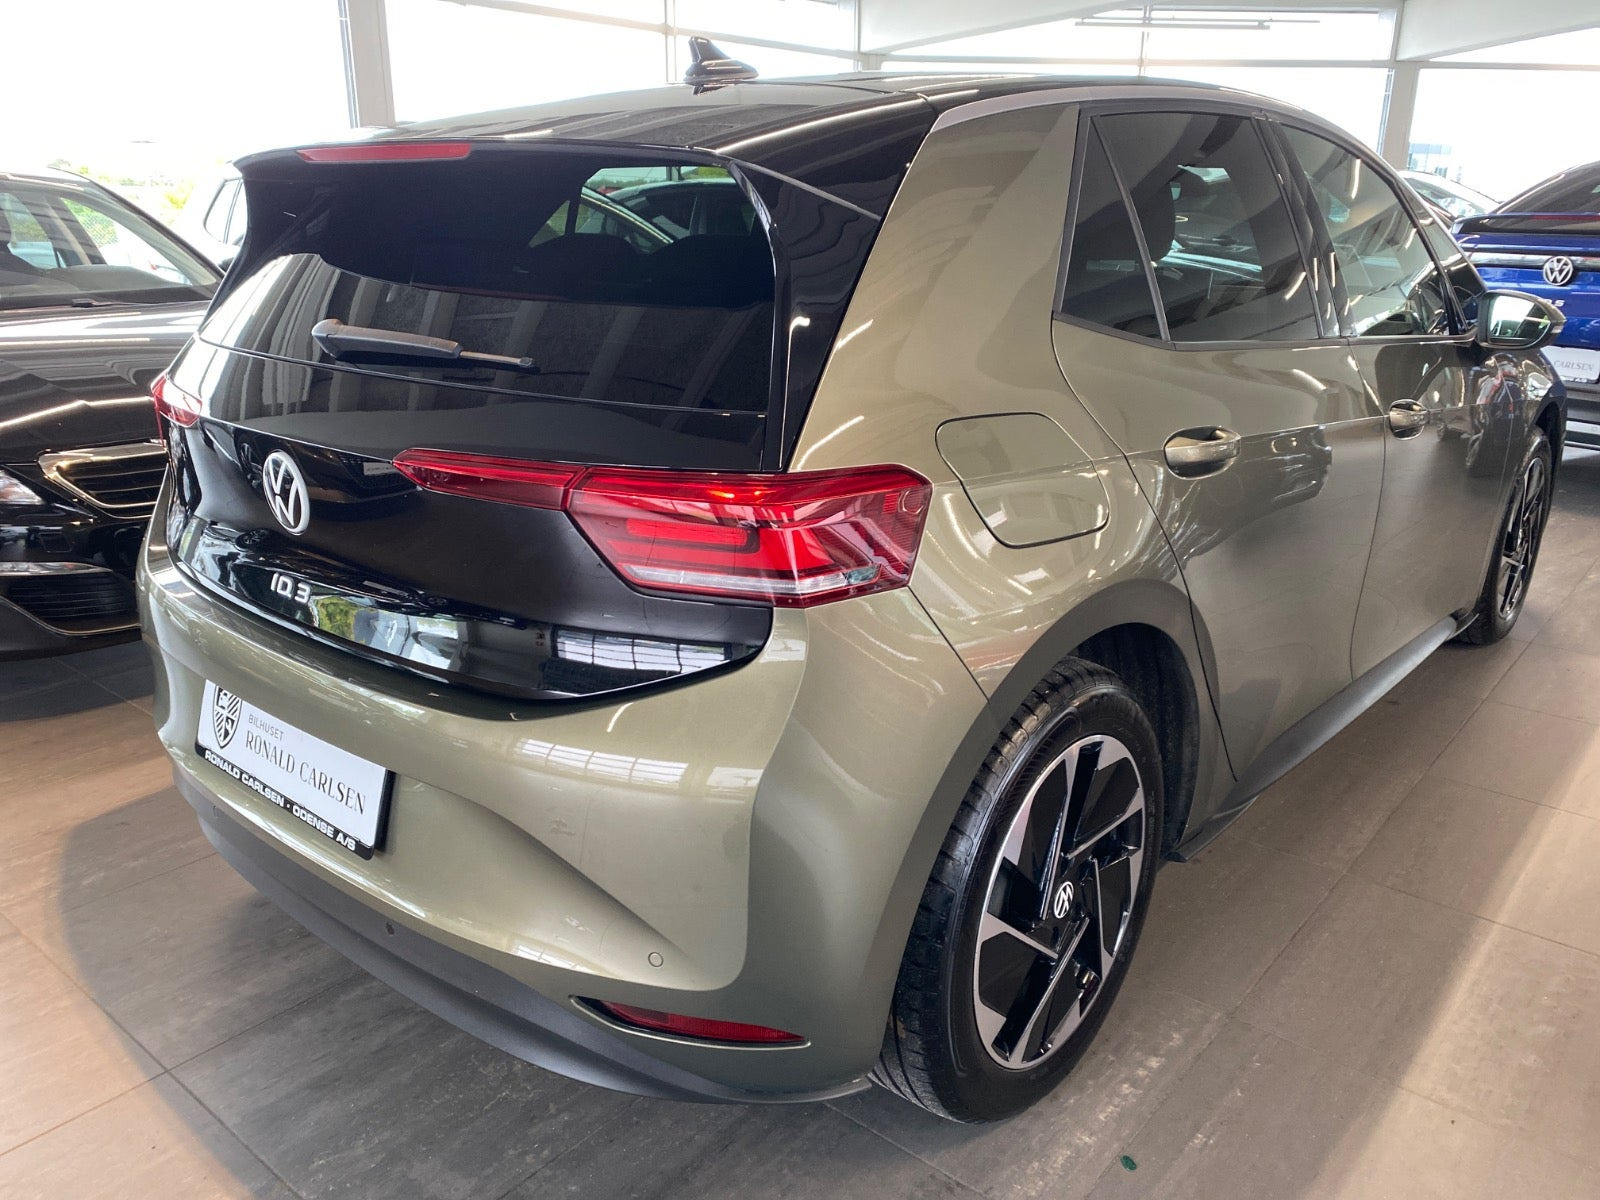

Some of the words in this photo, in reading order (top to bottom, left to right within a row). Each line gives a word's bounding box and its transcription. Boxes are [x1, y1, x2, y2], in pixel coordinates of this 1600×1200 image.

[248, 714, 284, 740] BILHUSET
[205, 750, 240, 779] RONALD
[242, 774, 284, 807] CARLSEN
[293, 806, 334, 838] ODENSE
[336, 833, 356, 851] A/S
[245, 730, 295, 774] RONALD
[299, 762, 366, 815] CARLSEN
